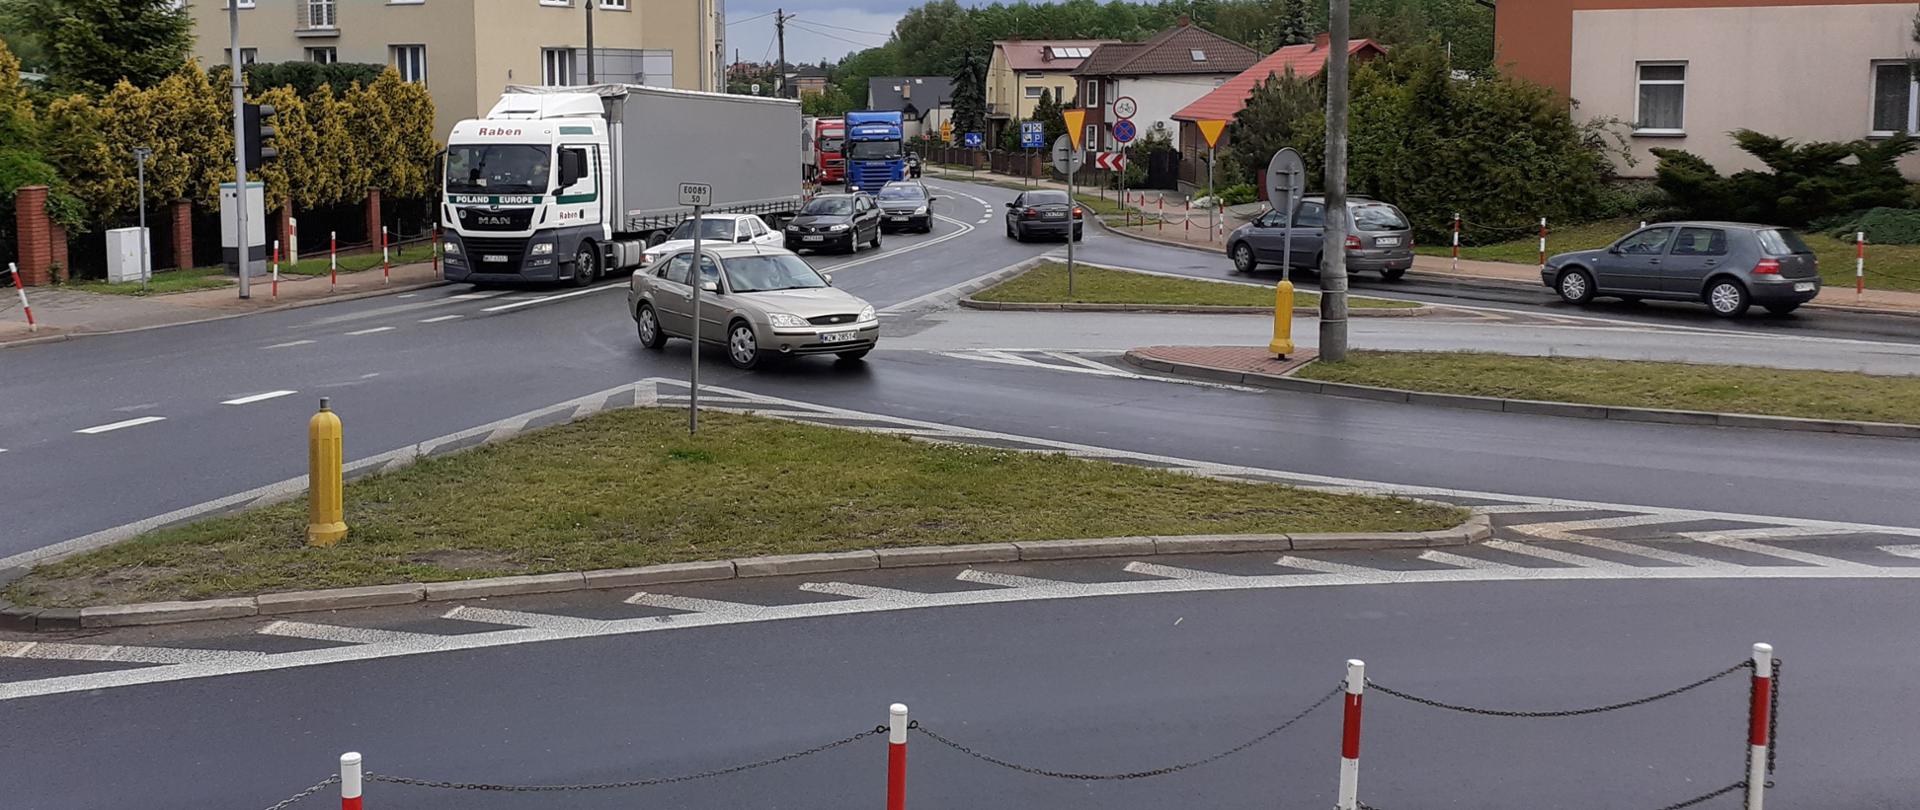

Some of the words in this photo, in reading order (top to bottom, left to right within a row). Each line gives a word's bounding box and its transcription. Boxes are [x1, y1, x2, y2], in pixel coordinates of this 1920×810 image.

[478, 127, 522, 136] Raben
[456, 196, 490, 204] POLAND
[500, 196, 534, 204] EUROPE
[691, 195, 701, 203] 50
[559, 209, 578, 220] Raben
[478, 216, 511, 225] MAN
